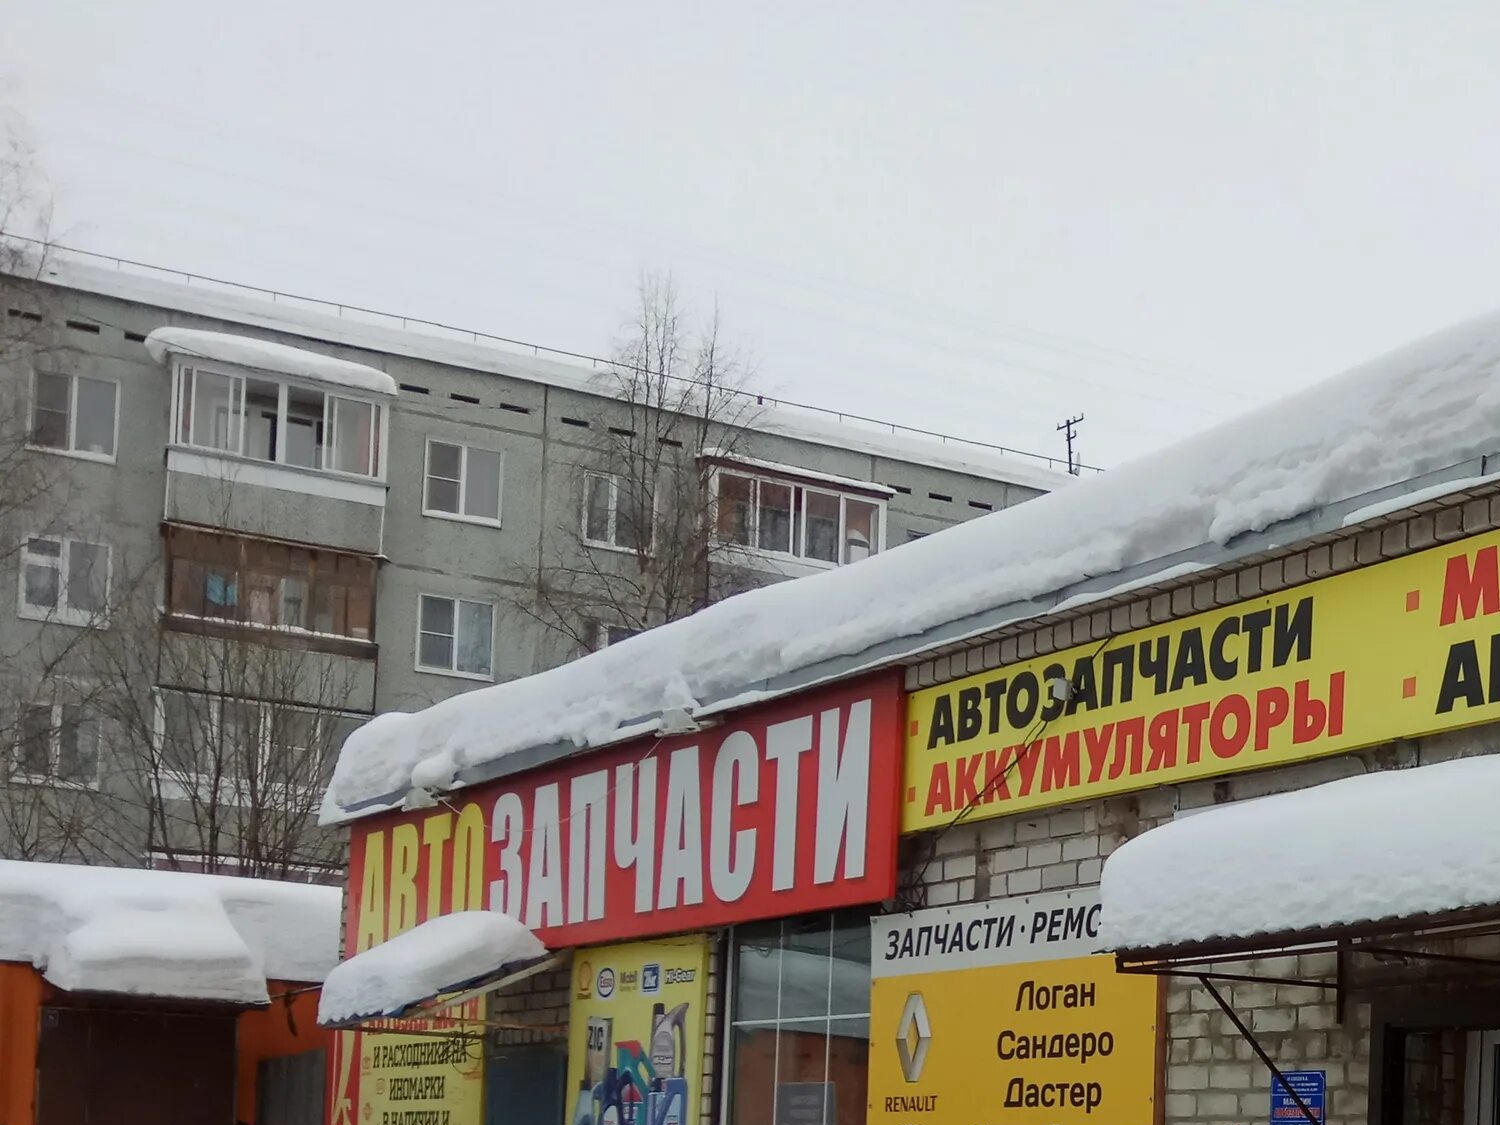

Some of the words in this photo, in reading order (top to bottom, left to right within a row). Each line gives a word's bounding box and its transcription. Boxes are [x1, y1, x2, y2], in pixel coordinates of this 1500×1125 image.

[927, 596, 1314, 749] АВТОЗАПЧАСТИ
[925, 671, 1346, 816] АККУМУЛЯТОРЫ
[356, 699, 873, 954] АВТОЗАПЧАСТИ
[885, 915, 1016, 960] ЗАПЧАСТИ
[1015, 980, 1096, 1012] Логан
[373, 1046, 381, 1068] И
[996, 1030, 1114, 1063] Сандеро
[388, 1076, 445, 1101] ИНОМАРКИ
[884, 1095, 938, 1113] RENAULT
[1003, 1078, 1102, 1113] Дастер
